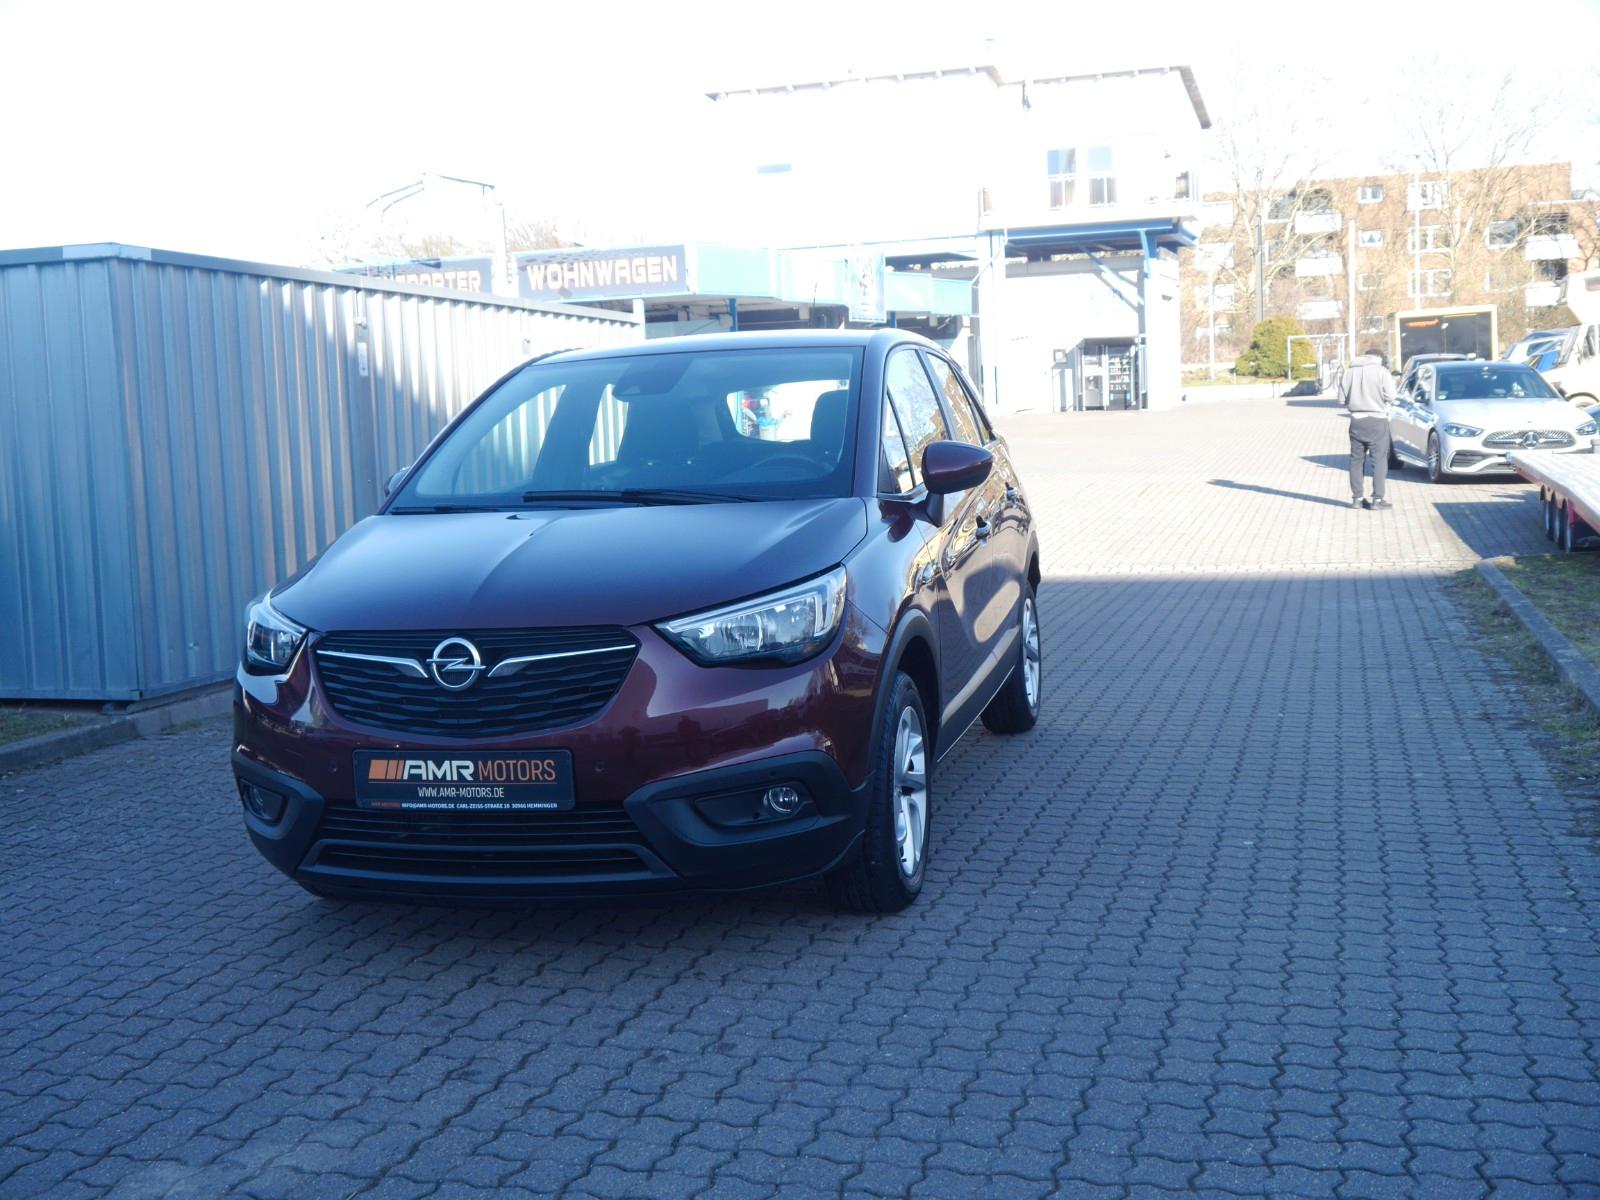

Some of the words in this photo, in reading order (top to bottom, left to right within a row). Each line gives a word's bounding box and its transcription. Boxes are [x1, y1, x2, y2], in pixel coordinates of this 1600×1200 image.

[526, 255, 678, 291] WOHNWAGEN
[402, 759, 475, 781] AMR
[478, 759, 556, 781] MOTORS
[417, 786, 505, 798] WWW.AMR-MOTORS.DE
